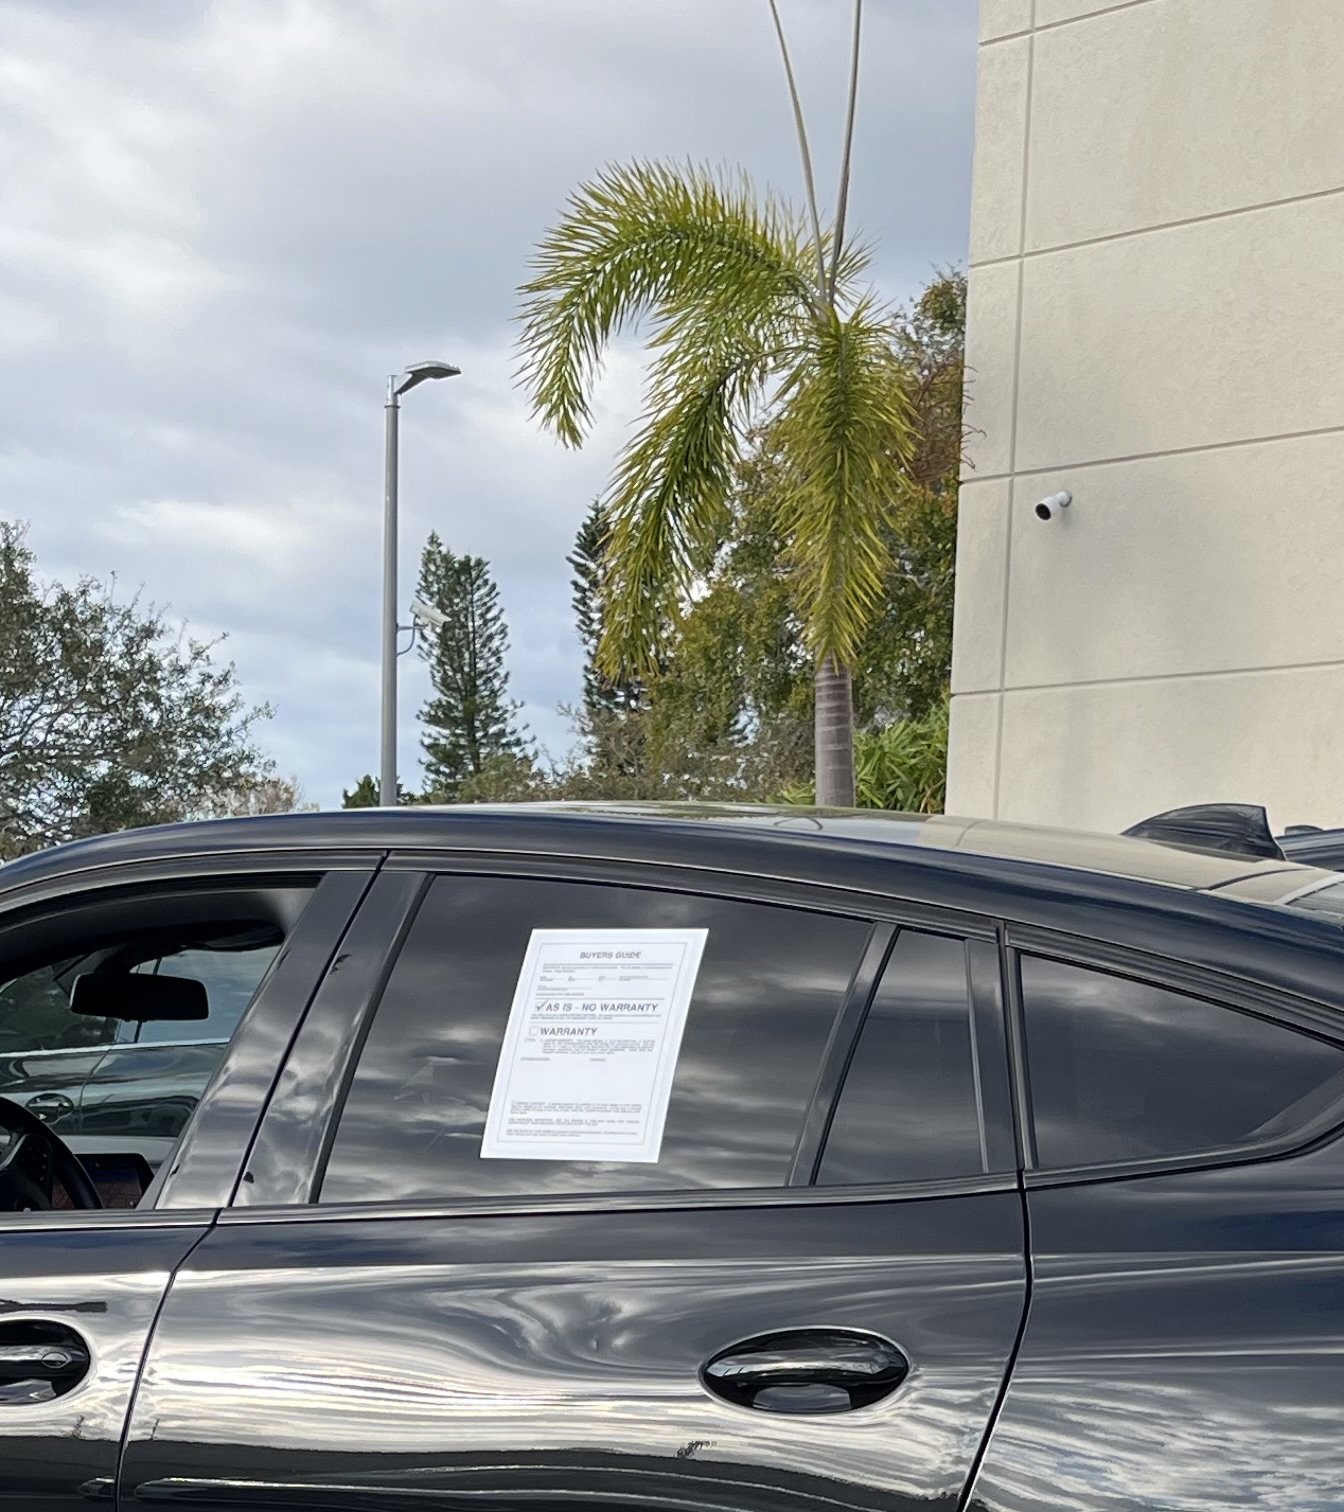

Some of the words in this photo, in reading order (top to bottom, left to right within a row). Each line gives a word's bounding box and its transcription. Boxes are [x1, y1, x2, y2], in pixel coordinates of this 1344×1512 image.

[579, 951, 613, 960] BUYERS
[615, 951, 642, 960] GUIDE
[545, 1002, 560, 1012] AS
[562, 1002, 573, 1012] IS
[581, 1002, 597, 1012] NO
[600, 1002, 659, 1013] WARRANTY
[539, 1026, 598, 1037] WARRANTY
